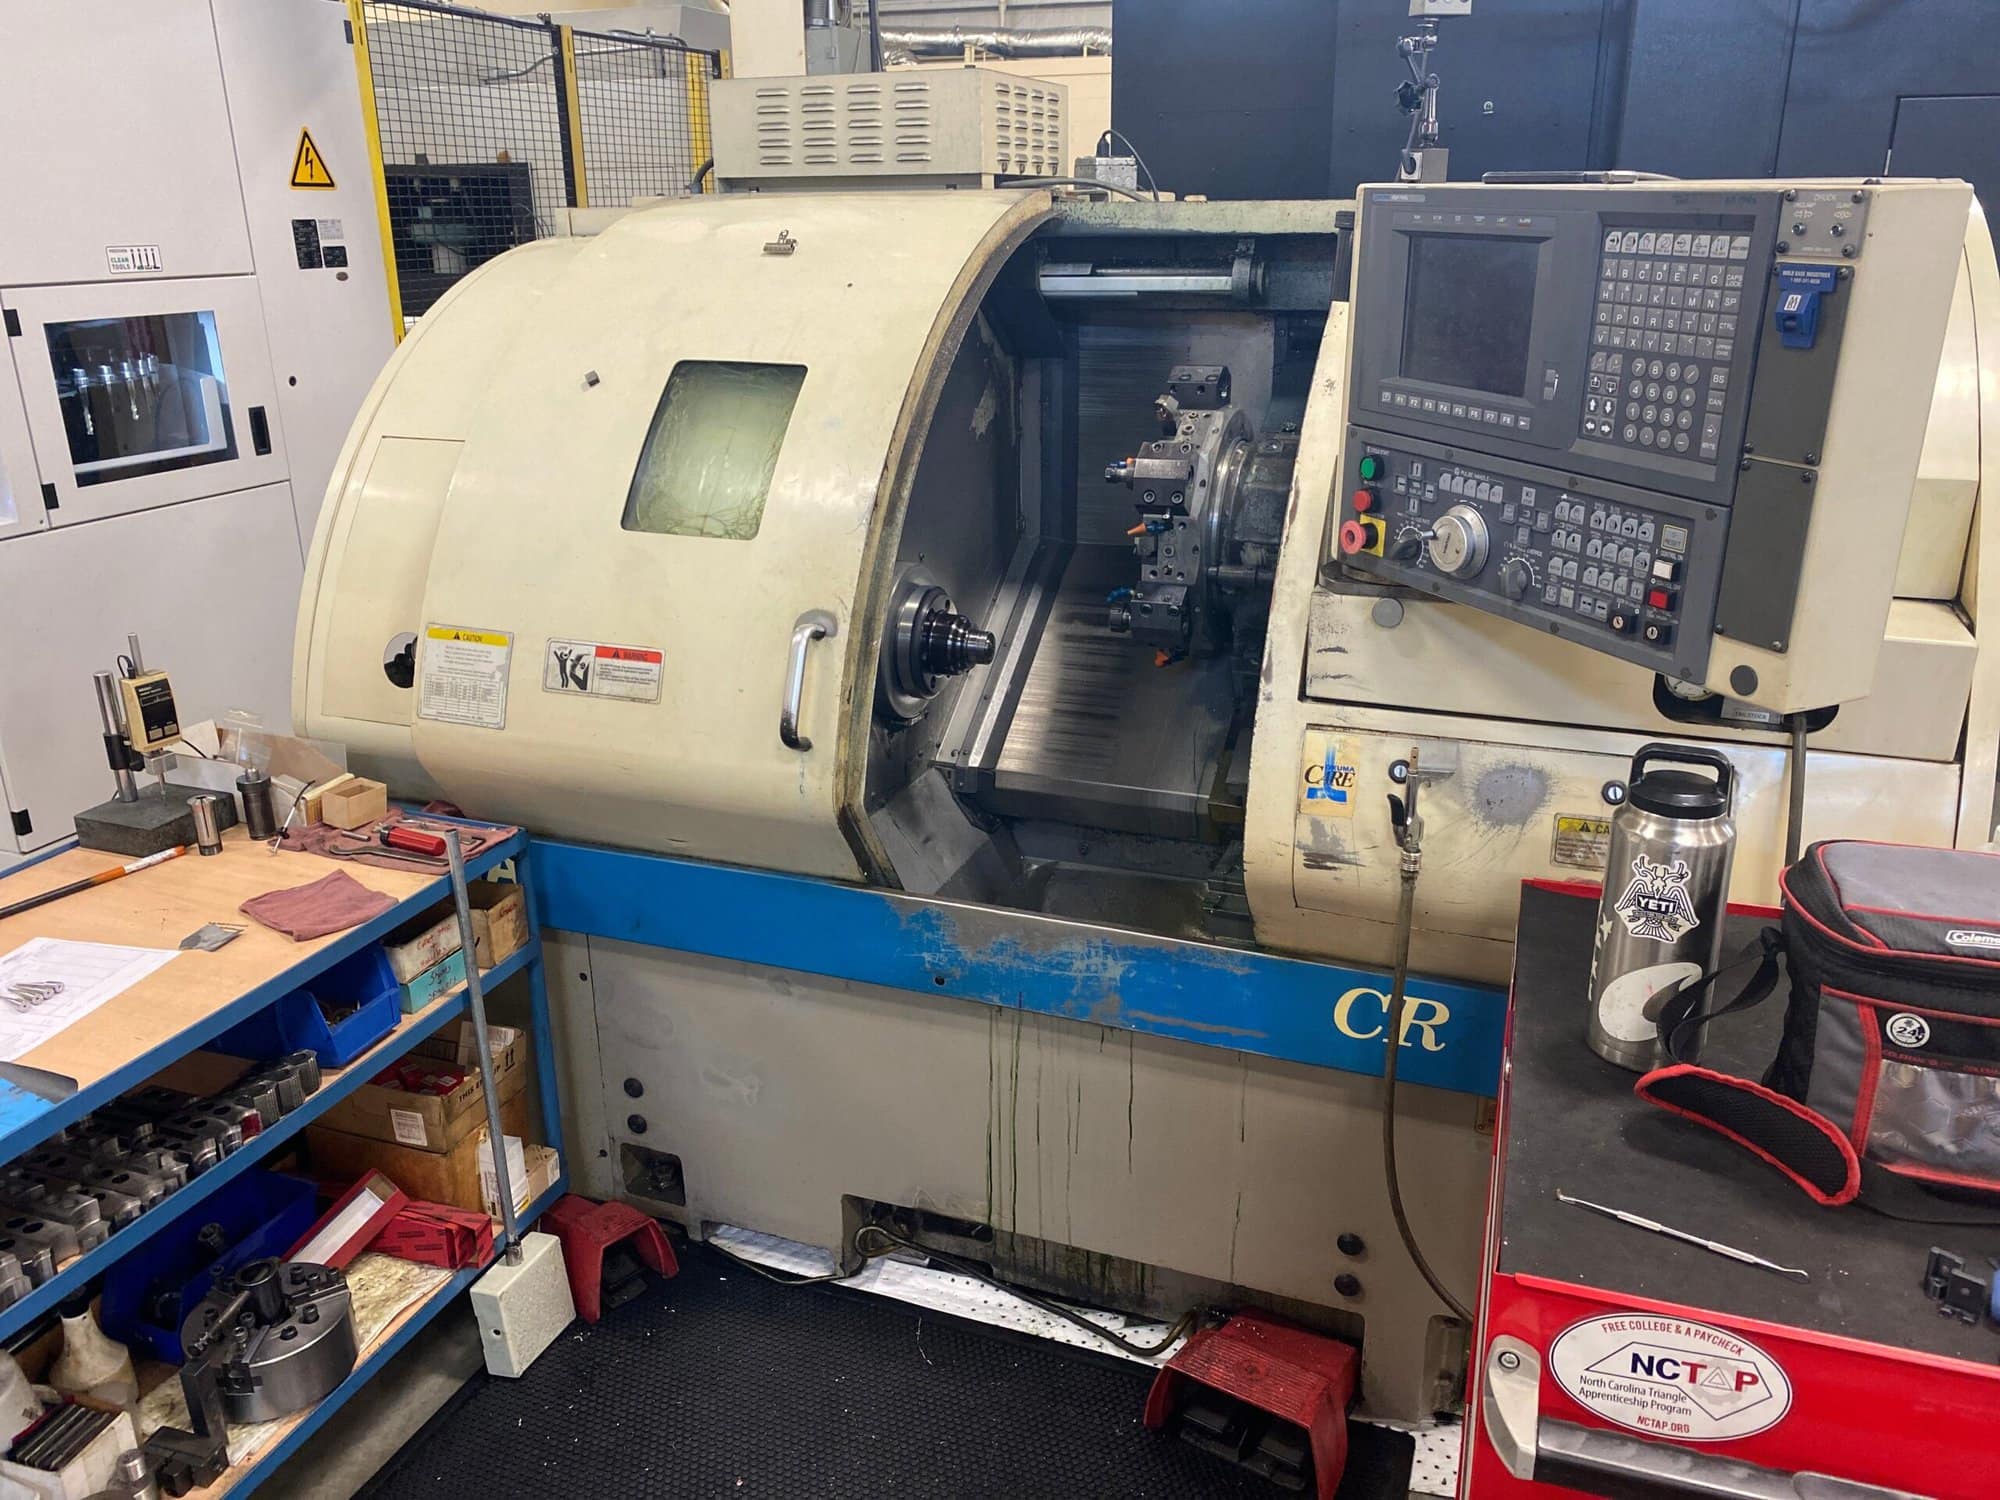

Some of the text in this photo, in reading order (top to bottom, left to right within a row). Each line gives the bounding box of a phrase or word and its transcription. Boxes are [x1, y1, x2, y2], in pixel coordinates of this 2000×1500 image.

[1605, 268, 1718, 284] A B C D E F G
[1602, 290, 1609, 299] H
[1636, 293, 1642, 302] J
[1653, 294, 1660, 303] K
[1671, 296, 1676, 305] L
[1688, 297, 1696, 306] M
[1707, 299, 1714, 308] N
[1724, 297, 1737, 306] SP
[1616, 314, 1623, 322] P
[1650, 318, 1656, 326] R
[1667, 319, 1674, 328] S
[1685, 321, 1692, 330] T
[1703, 323, 1711, 332] U
[1719, 322, 1735, 330] CTRL
[1598, 335, 1671, 351] V W X Y Z
[1636, 363, 1642, 372] 7
[1652, 366, 1659, 374] 8
[1670, 368, 1677, 376] 9
[1713, 375, 1724, 383] BS
[1632, 385, 1673, 399] 4 5 6
[1708, 398, 1722, 406] CAN
[1440, 404, 1447, 412] F4
[1486, 413, 1494, 421] F7
[1502, 416, 1511, 424] F8
[1646, 410, 1653, 419] 2
[1663, 413, 1670, 422] 3
[1626, 429, 1633, 438] 0
[462, 633, 482, 642] CAUTION
[1638, 896, 1674, 912] YETI
[1952, 933, 2000, 945] Colema
[1334, 987, 1450, 1052] CR
[459, 1086, 474, 1103] THIS
[1602, 1320, 1744, 1356] FREE COLLEGE & A PAYCHECK
[1579, 1375, 1688, 1404] North Carolina Triangle
[1578, 1387, 1692, 1416] Apprenticeship Program
[1636, 1415, 1690, 1434] NCTAP.ORG
